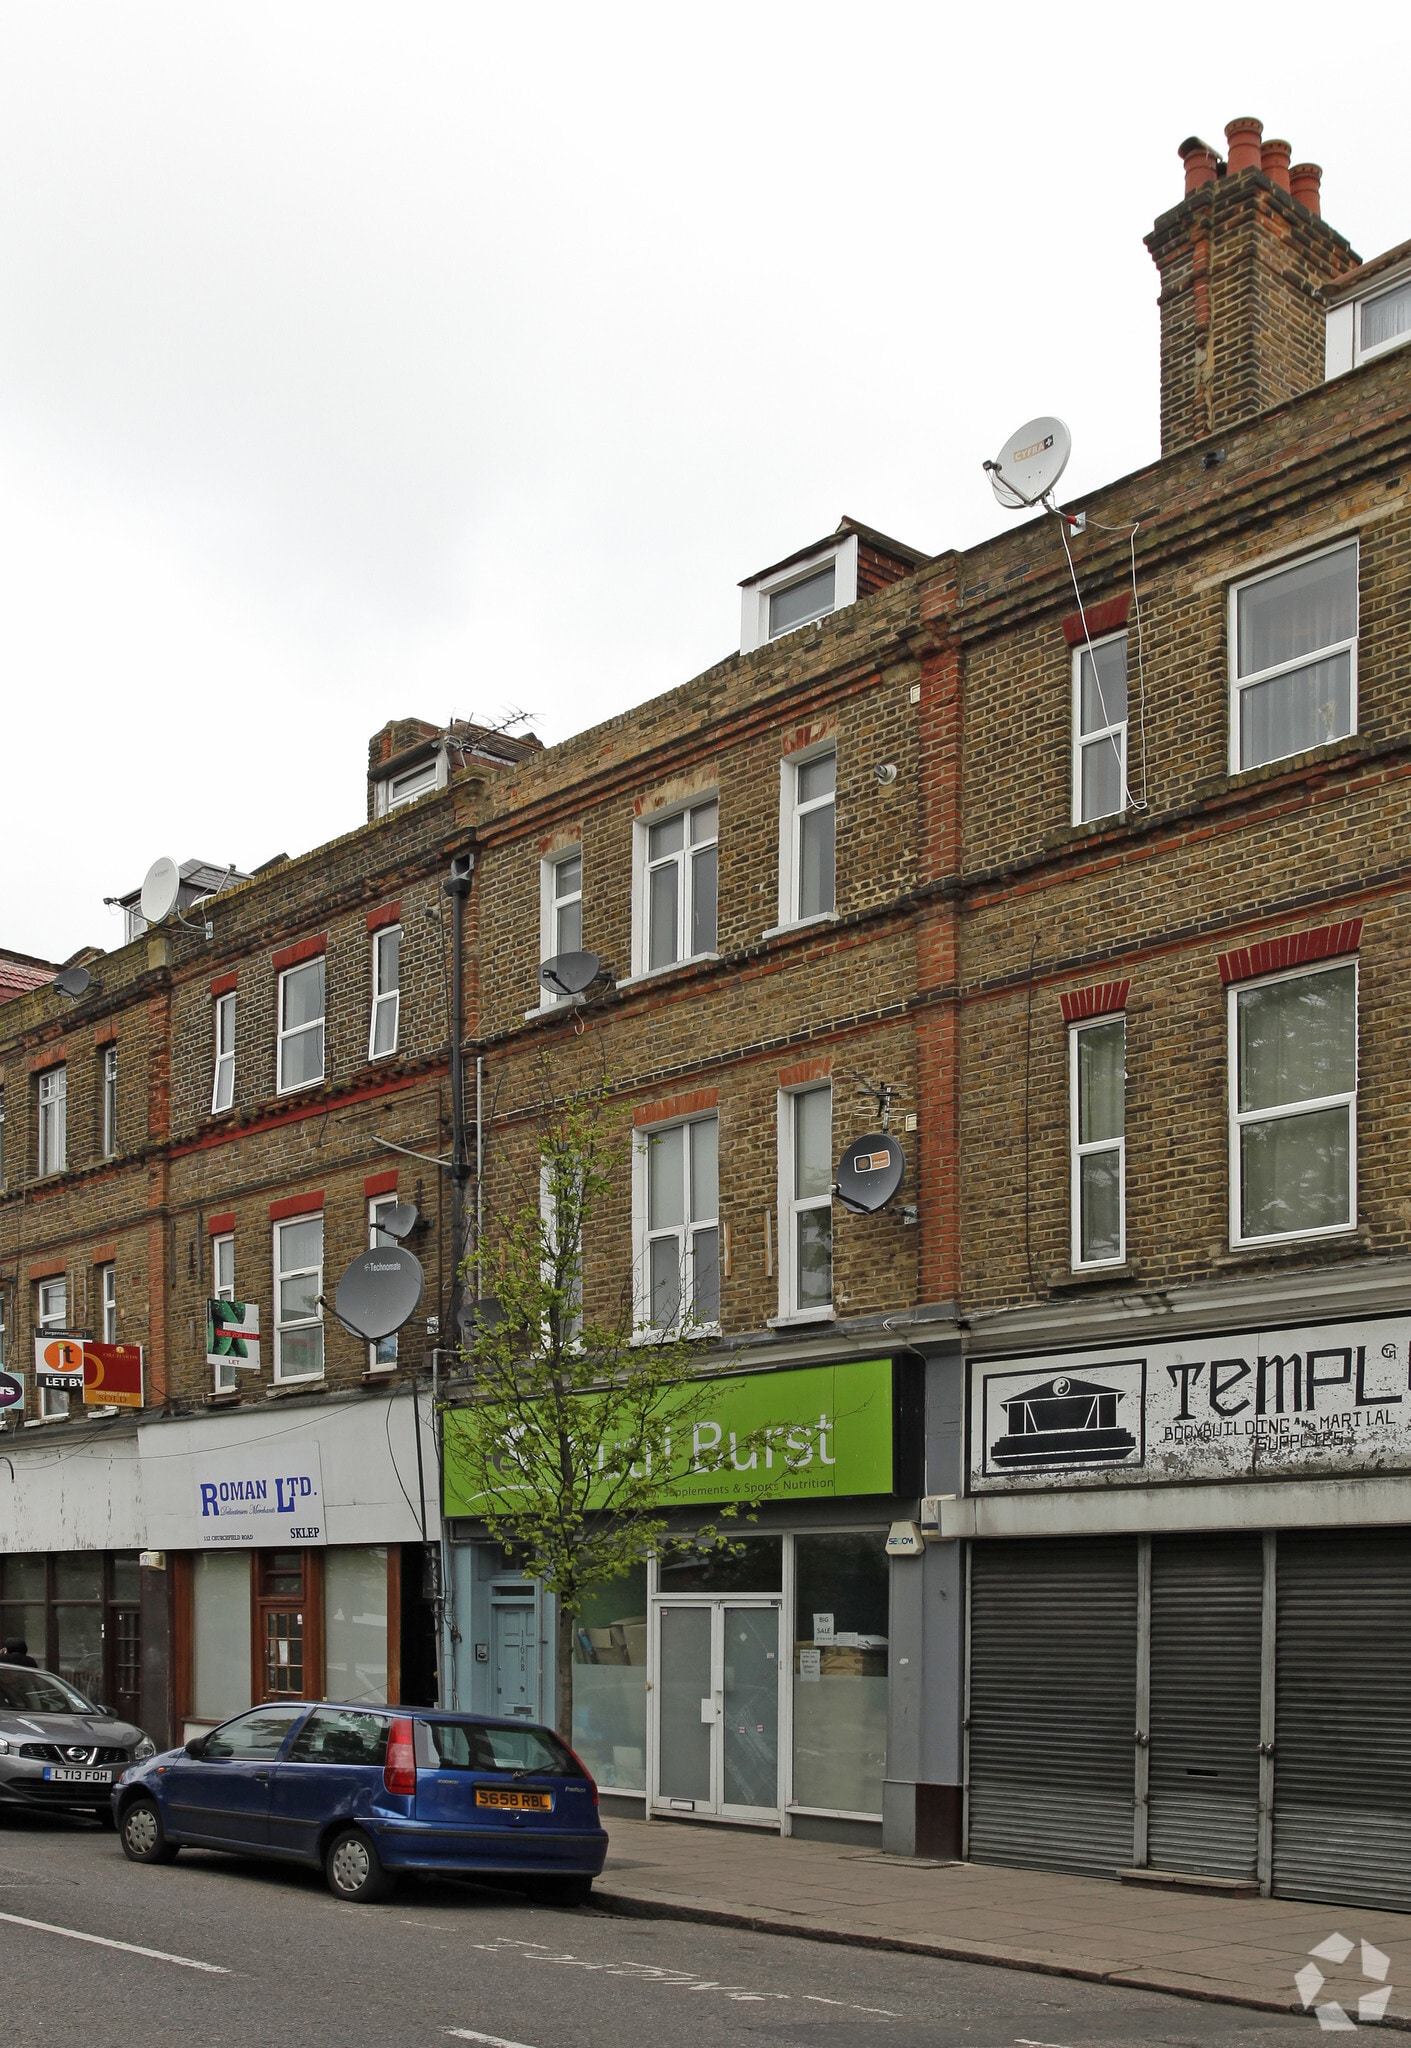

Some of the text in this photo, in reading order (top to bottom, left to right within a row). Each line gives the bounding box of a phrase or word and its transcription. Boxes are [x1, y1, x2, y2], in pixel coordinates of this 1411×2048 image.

[45, 1377, 67, 1387] LET
[99, 1395, 128, 1403] SOLD
[693, 1414, 836, 1473] Burst
[733, 1484, 740, 1493] &
[783, 1478, 834, 1490] Nutrition
[200, 1480, 267, 1516] ROMAN
[290, 1528, 320, 1539] SKLEP
[55, 1770, 107, 1781] LT13 FOH
[480, 1792, 548, 1807] S658 RBL
